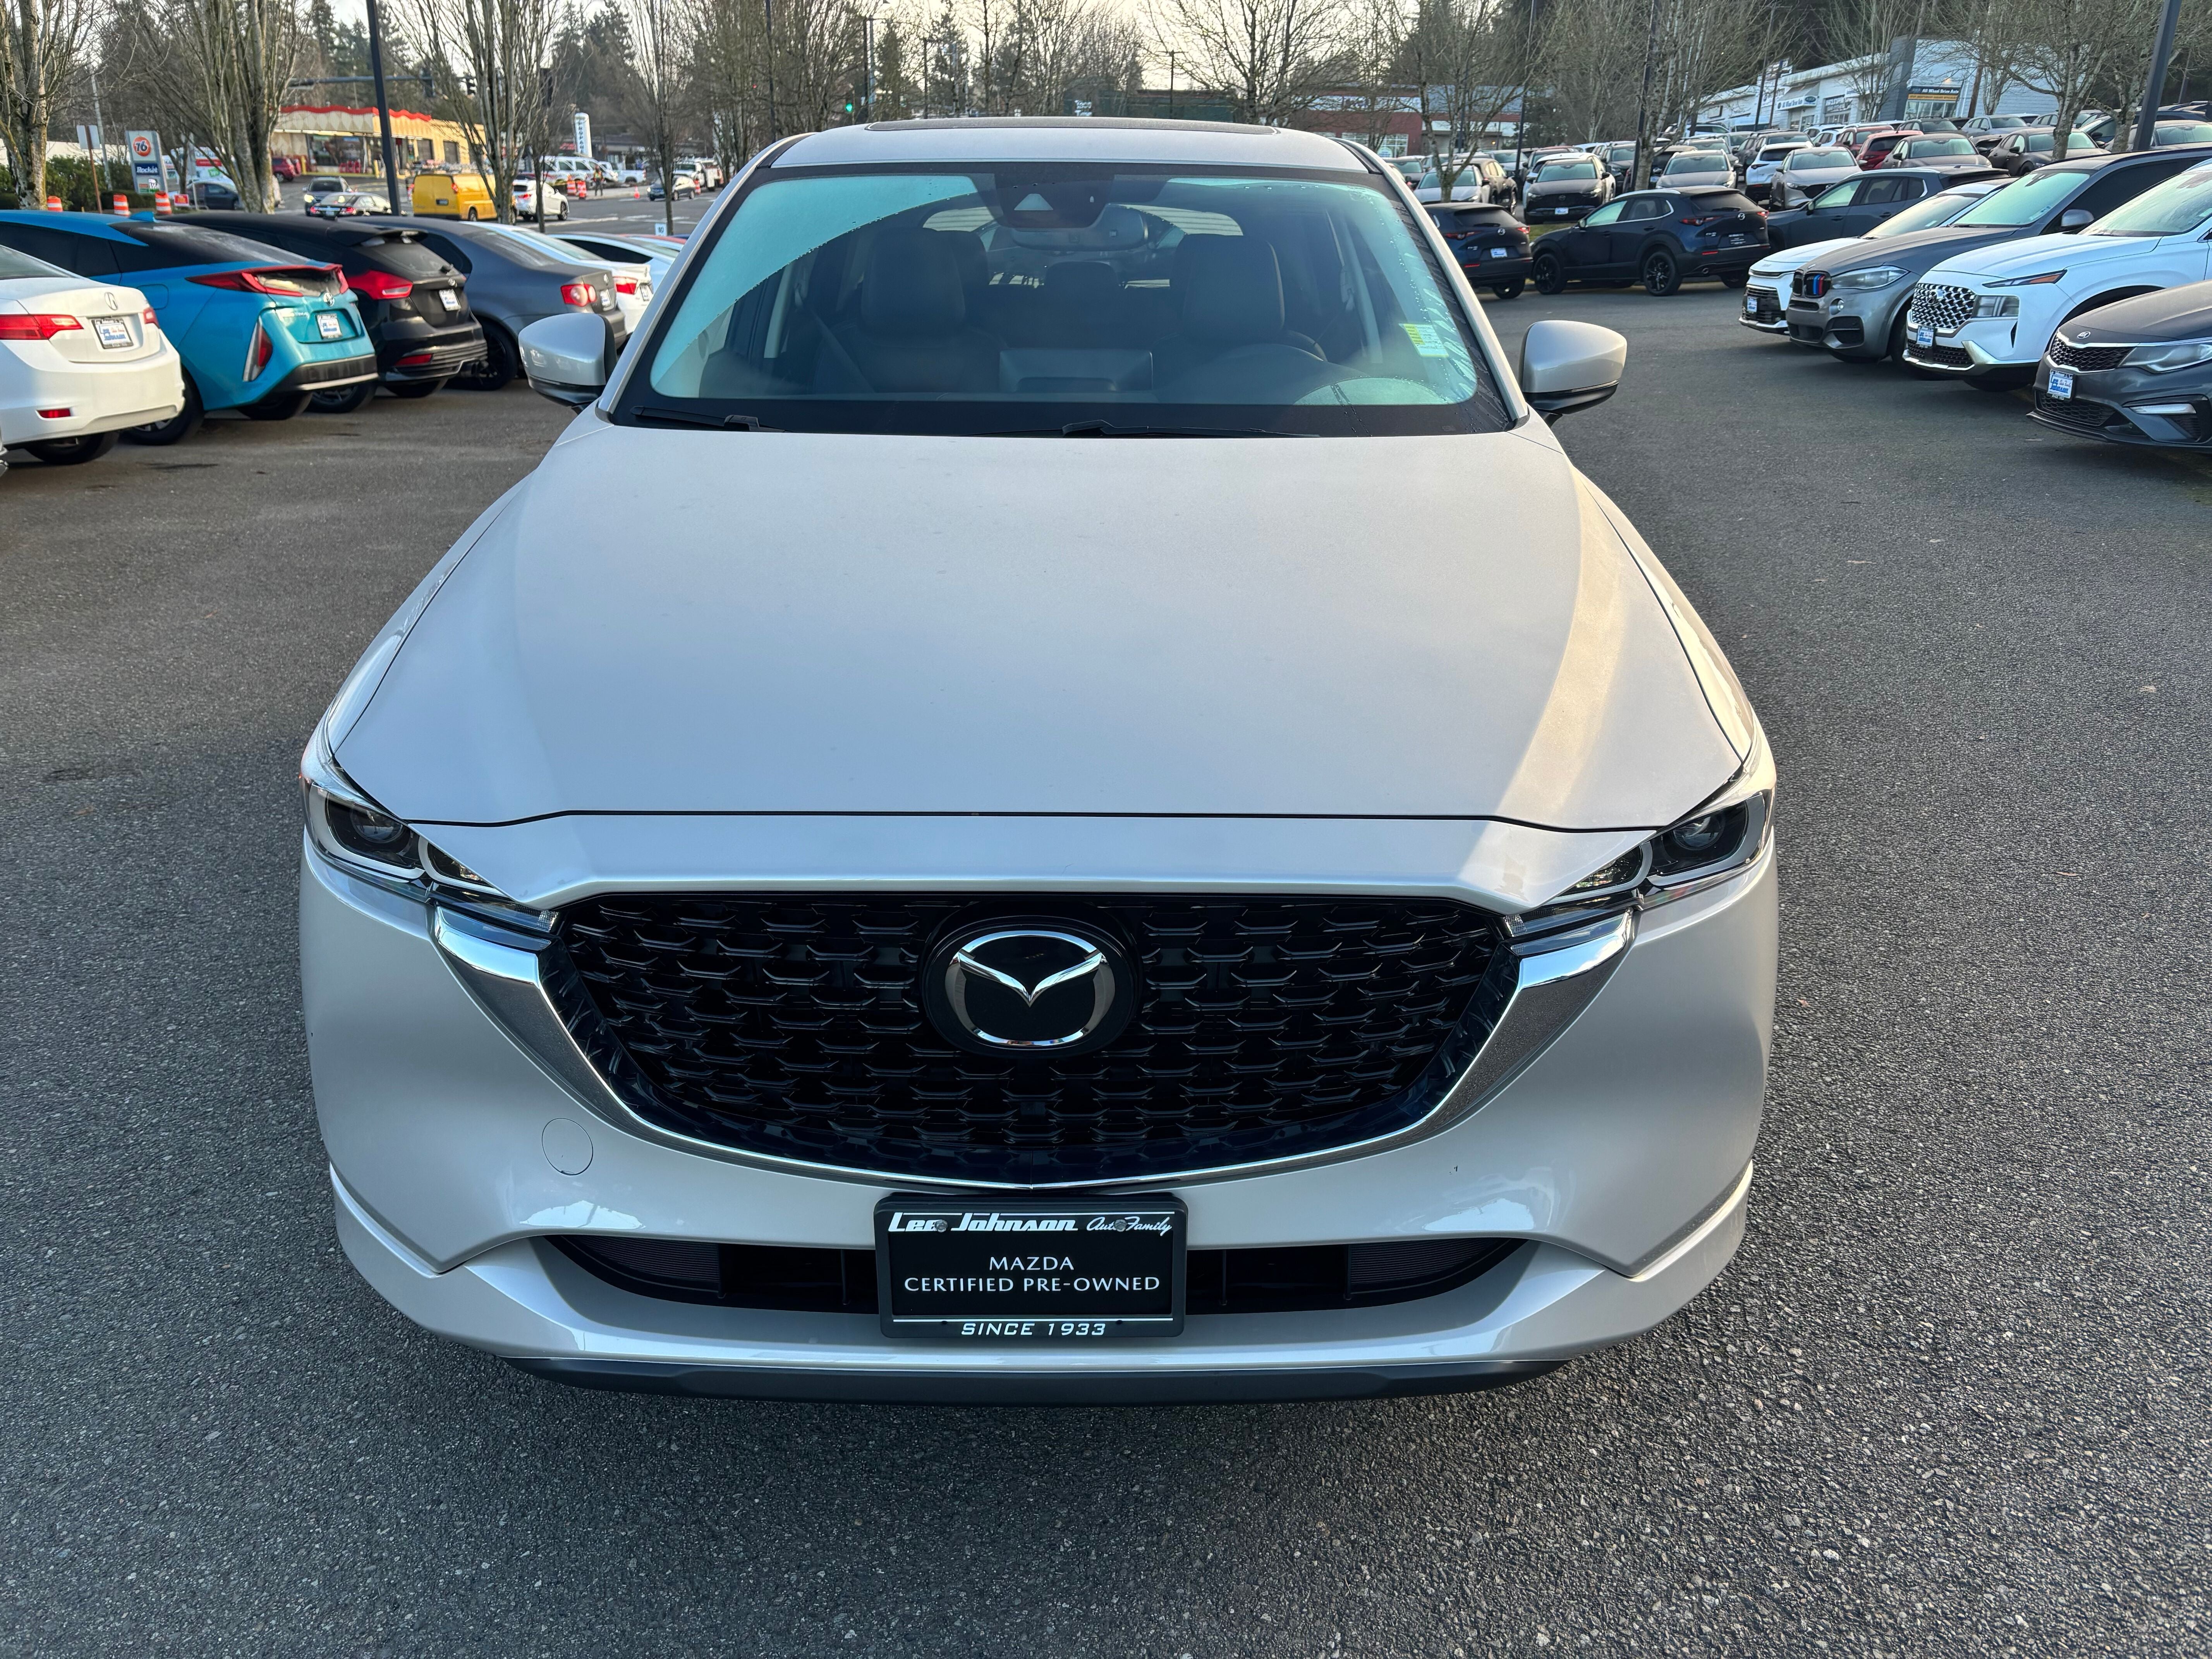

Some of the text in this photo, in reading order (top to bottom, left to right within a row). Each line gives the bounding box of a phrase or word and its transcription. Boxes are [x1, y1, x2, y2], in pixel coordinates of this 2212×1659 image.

[136, 141, 148, 152] 76
[951, 1212, 1079, 1231] Johnson
[1087, 1217, 1117, 1231] Aut
[1125, 1216, 1172, 1237] Family
[989, 1257, 1074, 1270] MAZDA
[905, 1277, 1159, 1291] CERTIFIED PRE-OWNED
[961, 1323, 1106, 1336] SINCE 1933
